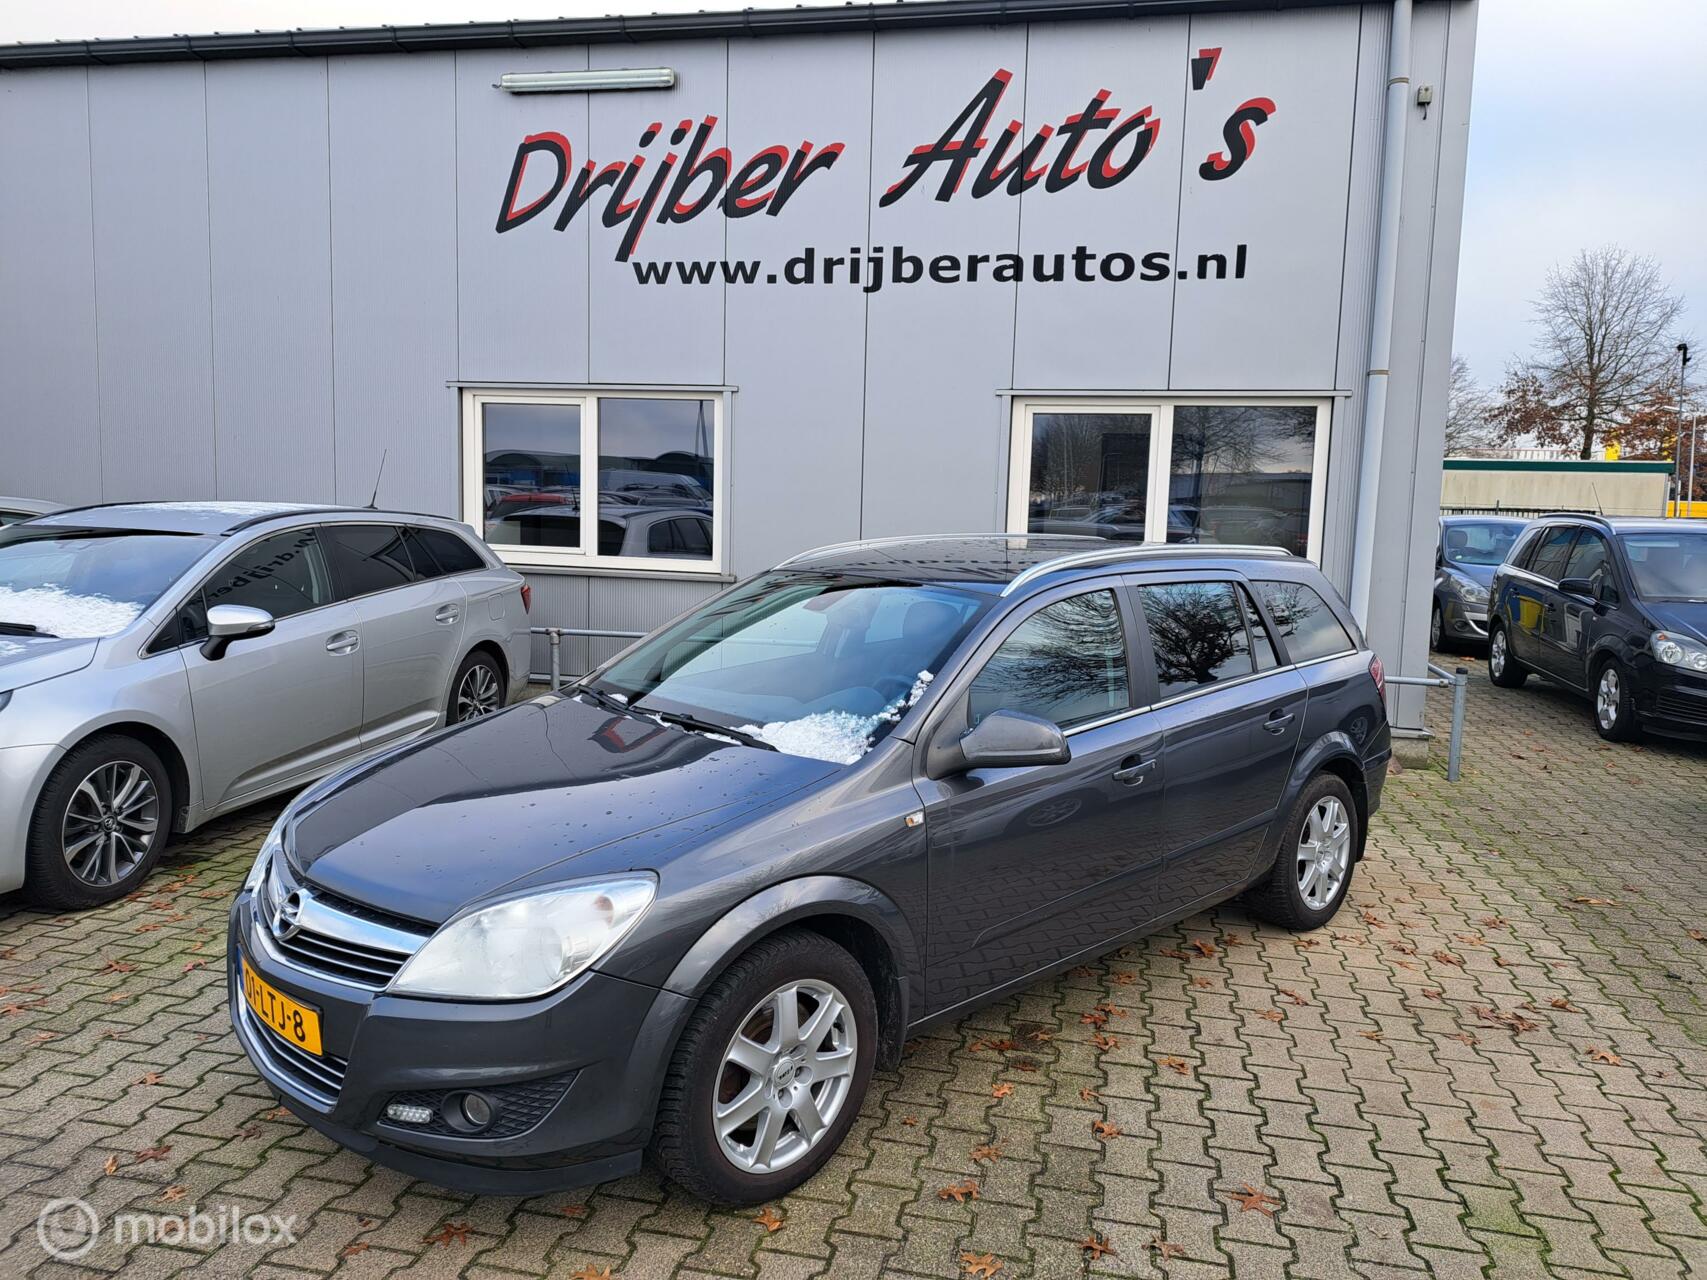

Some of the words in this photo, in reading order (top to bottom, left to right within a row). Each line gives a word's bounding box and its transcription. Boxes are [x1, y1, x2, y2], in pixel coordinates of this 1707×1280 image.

[497, 116, 845, 262] Drijber
[880, 48, 1275, 208] Auto's
[633, 244, 1247, 292] www.drijberautos.nl
[245, 968, 306, 1042] 01-LTJ-8
